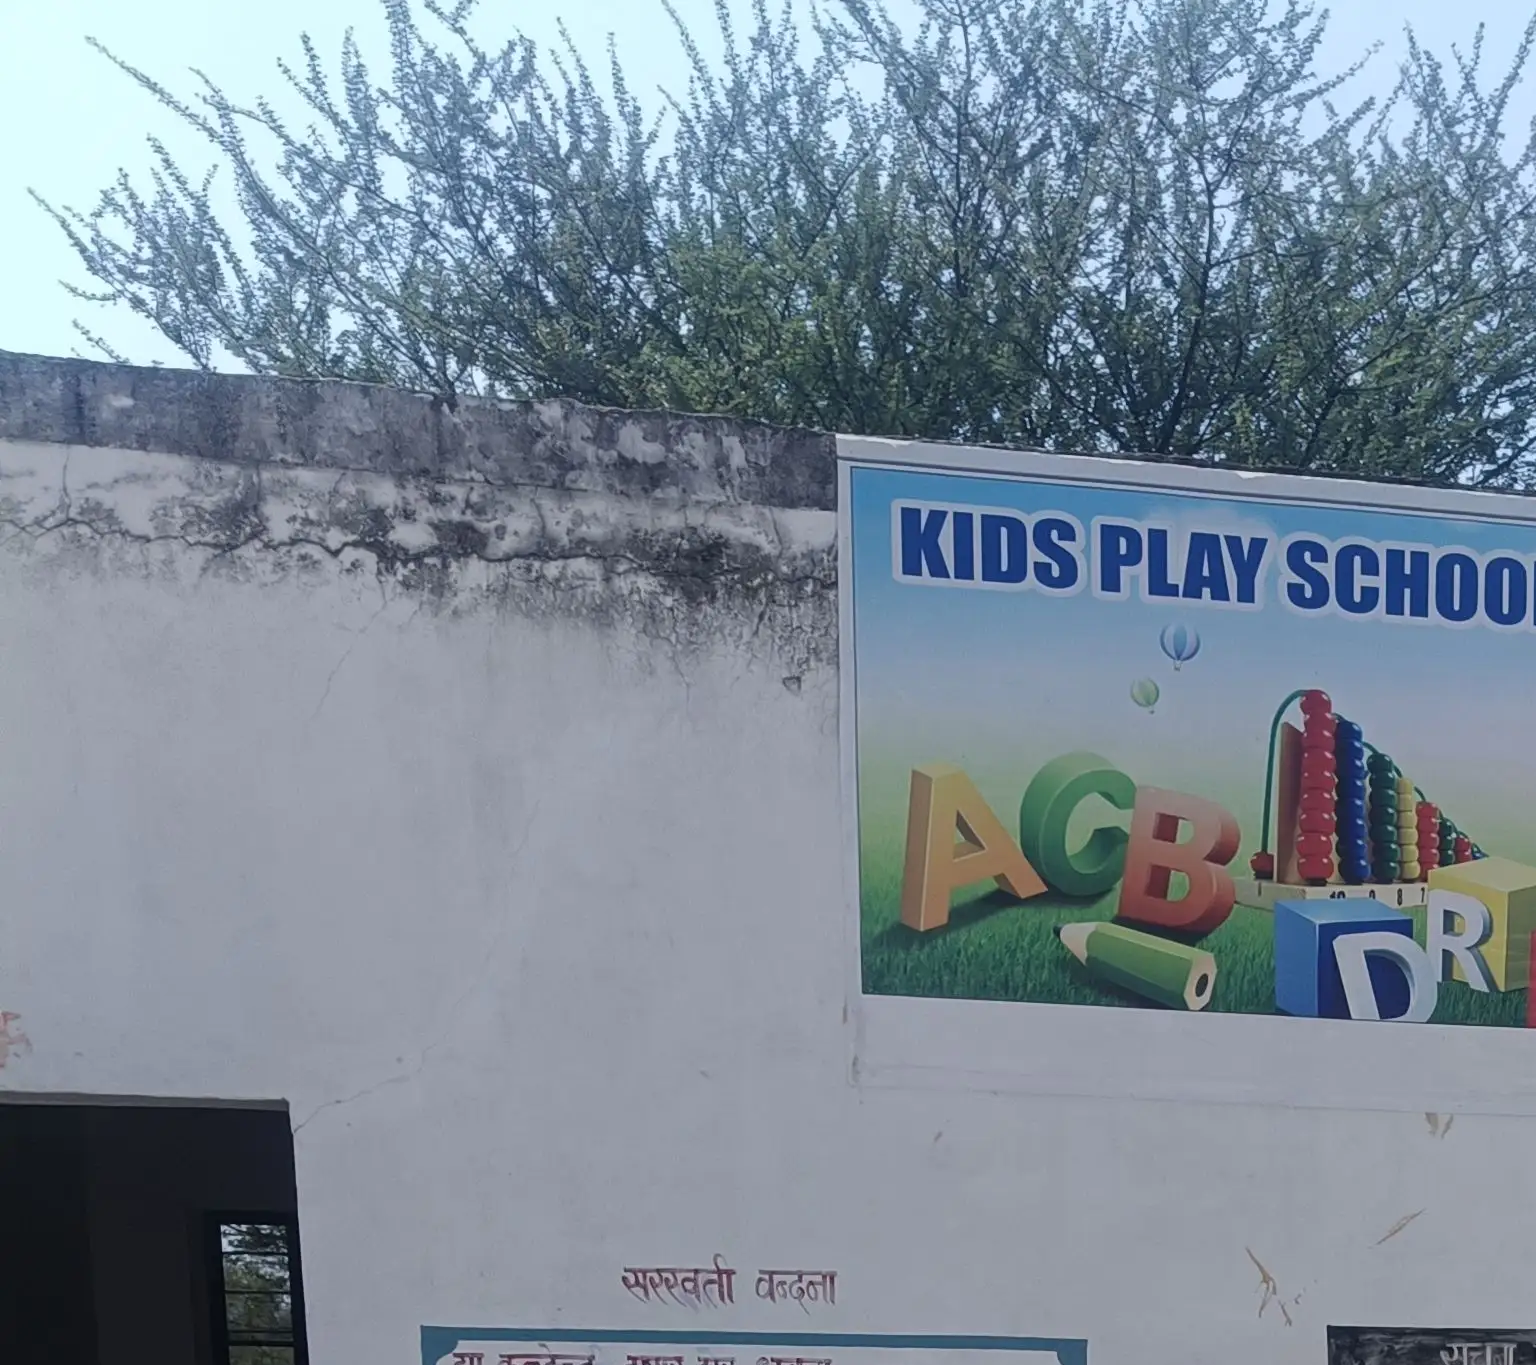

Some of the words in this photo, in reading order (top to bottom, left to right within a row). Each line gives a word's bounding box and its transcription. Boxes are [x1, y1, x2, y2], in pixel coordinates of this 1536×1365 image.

[900, 506, 1079, 589] KIDS
[1100, 524, 1269, 604] PLAY
[755, 1269, 837, 1315] वन्दना
